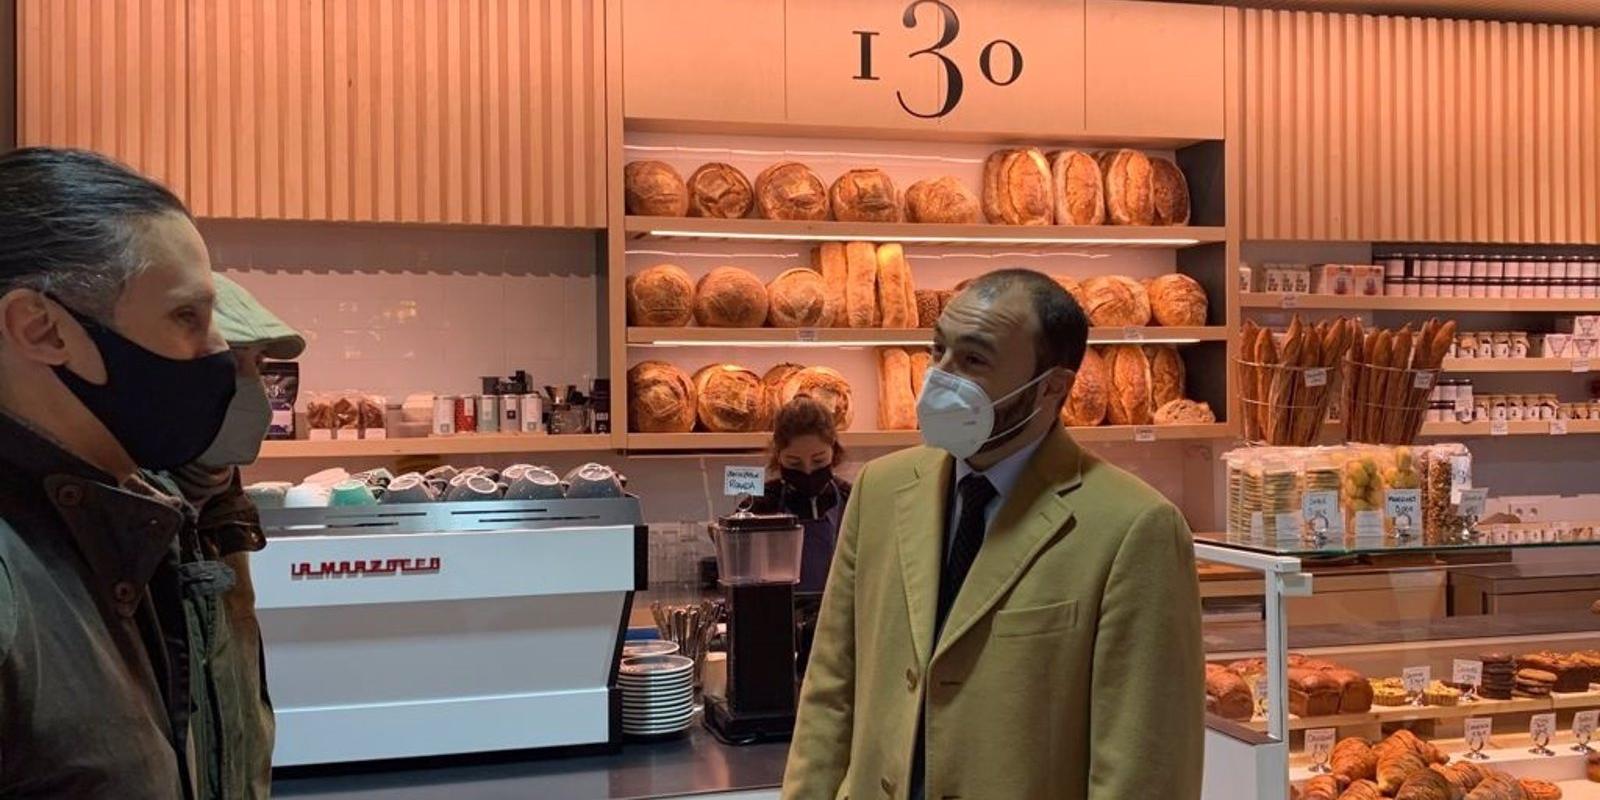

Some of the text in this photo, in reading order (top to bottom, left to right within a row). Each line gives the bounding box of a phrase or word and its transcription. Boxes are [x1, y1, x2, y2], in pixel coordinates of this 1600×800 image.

[852, 0, 1024, 119] 130
[291, 557, 441, 576] LA MARZOCCO
